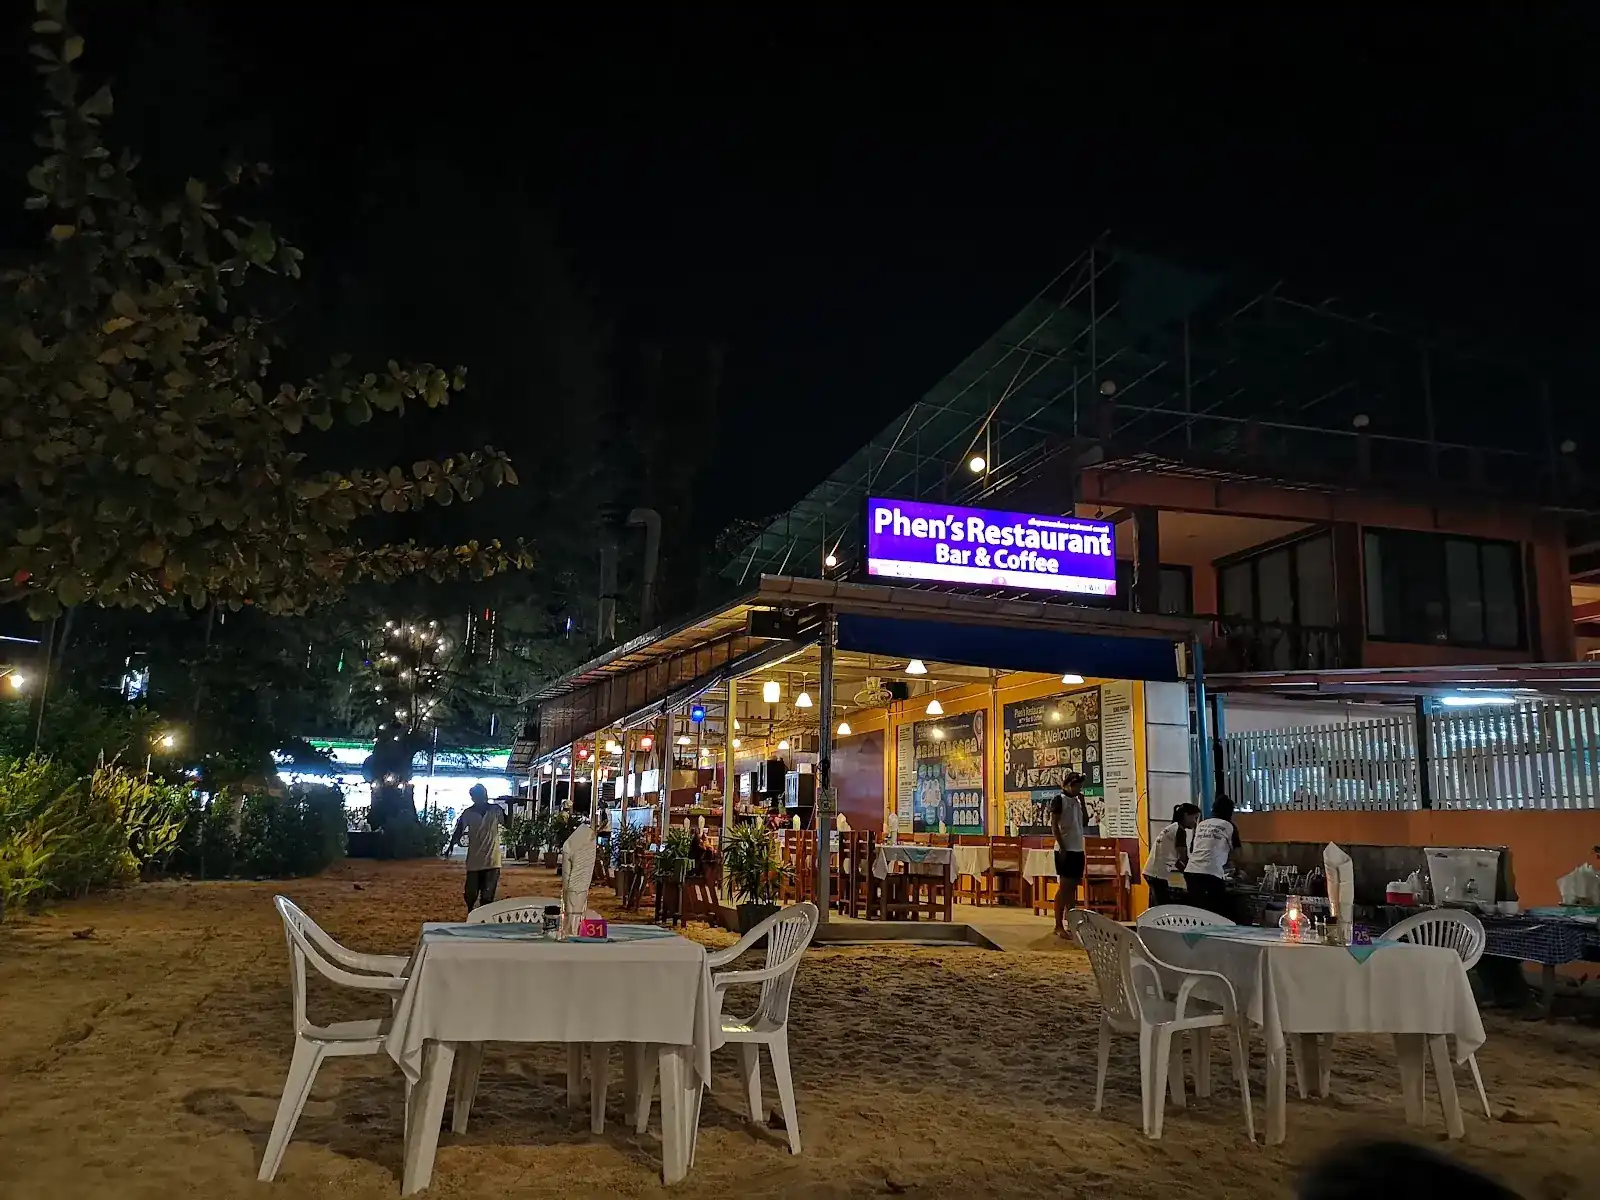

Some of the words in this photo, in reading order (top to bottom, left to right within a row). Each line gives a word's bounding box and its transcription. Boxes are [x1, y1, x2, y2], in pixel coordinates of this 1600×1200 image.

[874, 507, 964, 542] Phen's
[966, 517, 1112, 556] Restaurant
[935, 543, 971, 566] Bar
[975, 547, 991, 568] &
[993, 549, 1059, 574] Coffee
[1044, 725, 1082, 744] Welcome
[587, 923, 603, 937] 31
[1355, 930, 1370, 942] 25
